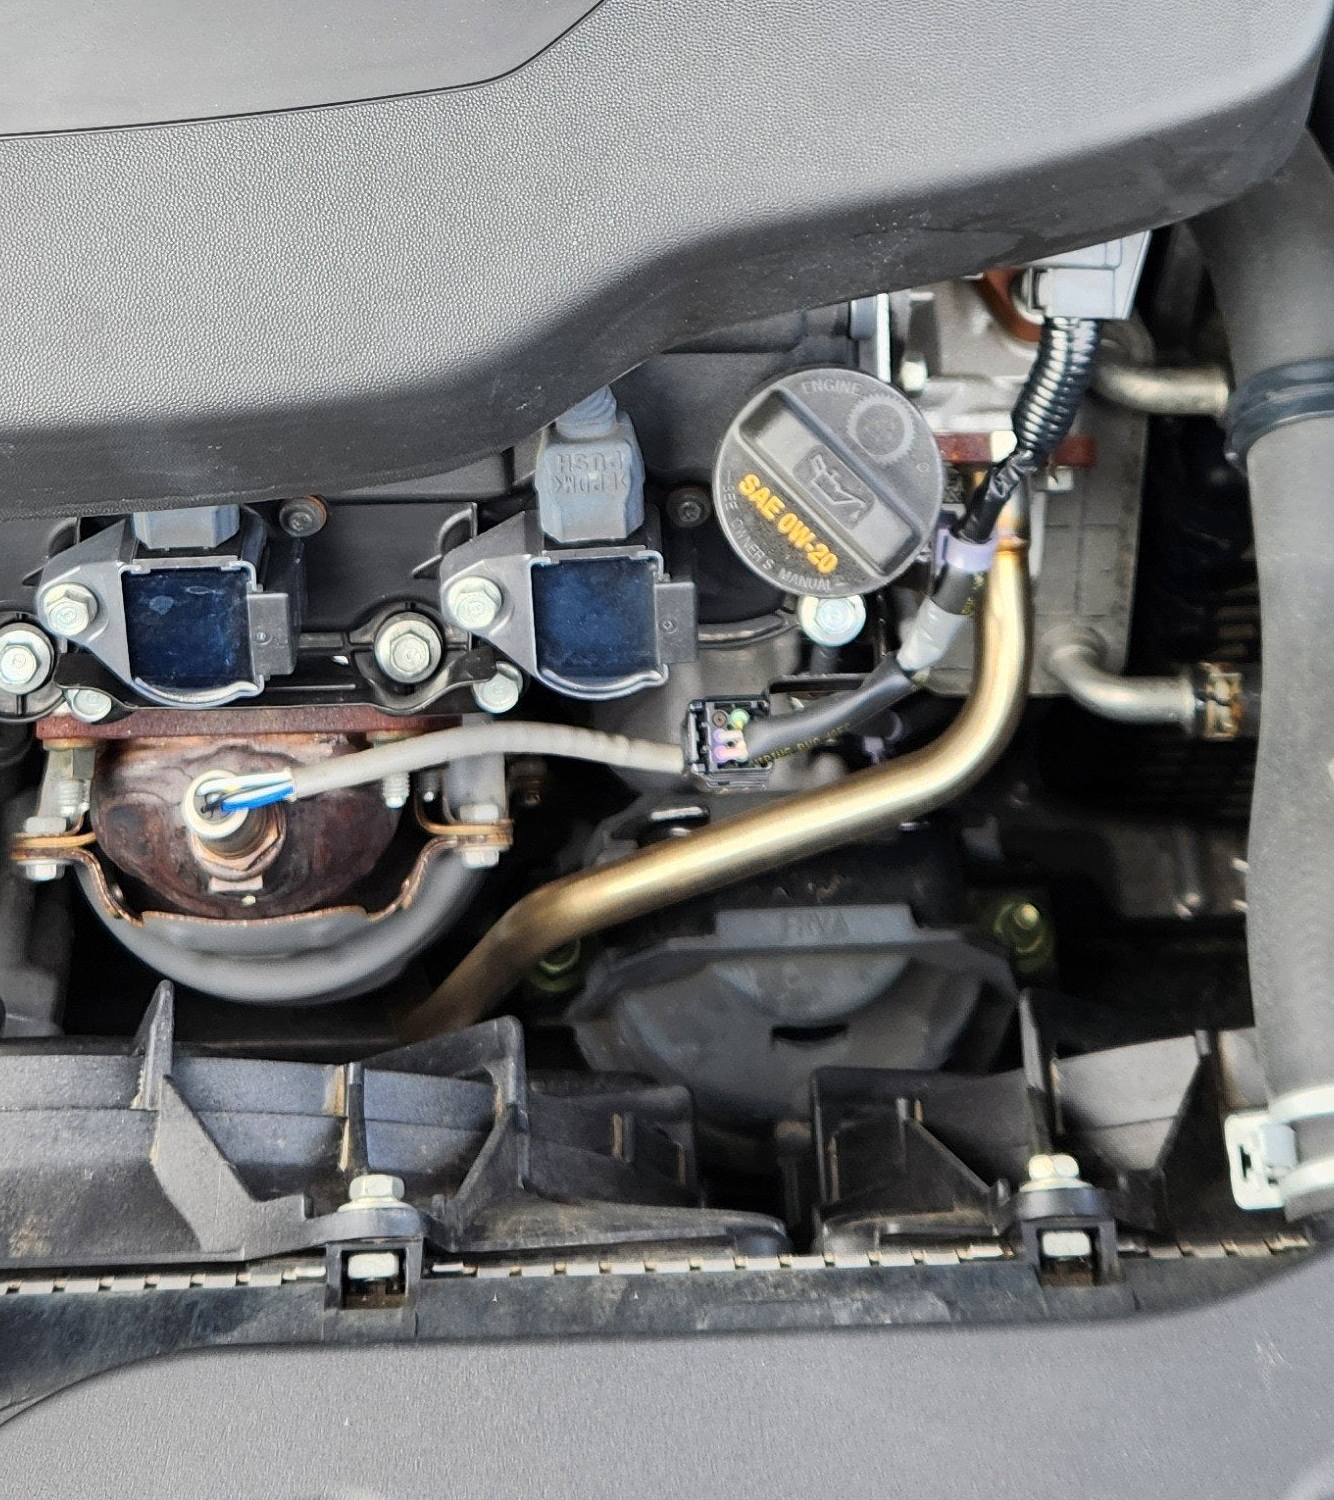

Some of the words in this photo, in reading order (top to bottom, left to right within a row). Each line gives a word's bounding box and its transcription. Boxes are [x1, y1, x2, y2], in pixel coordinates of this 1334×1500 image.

[800, 378, 864, 396] ENGINE
[556, 450, 624, 474] PUSH
[738, 474, 786, 521] SAE
[777, 512, 839, 574] 0W-20
[777, 567, 833, 591] MANUAL
